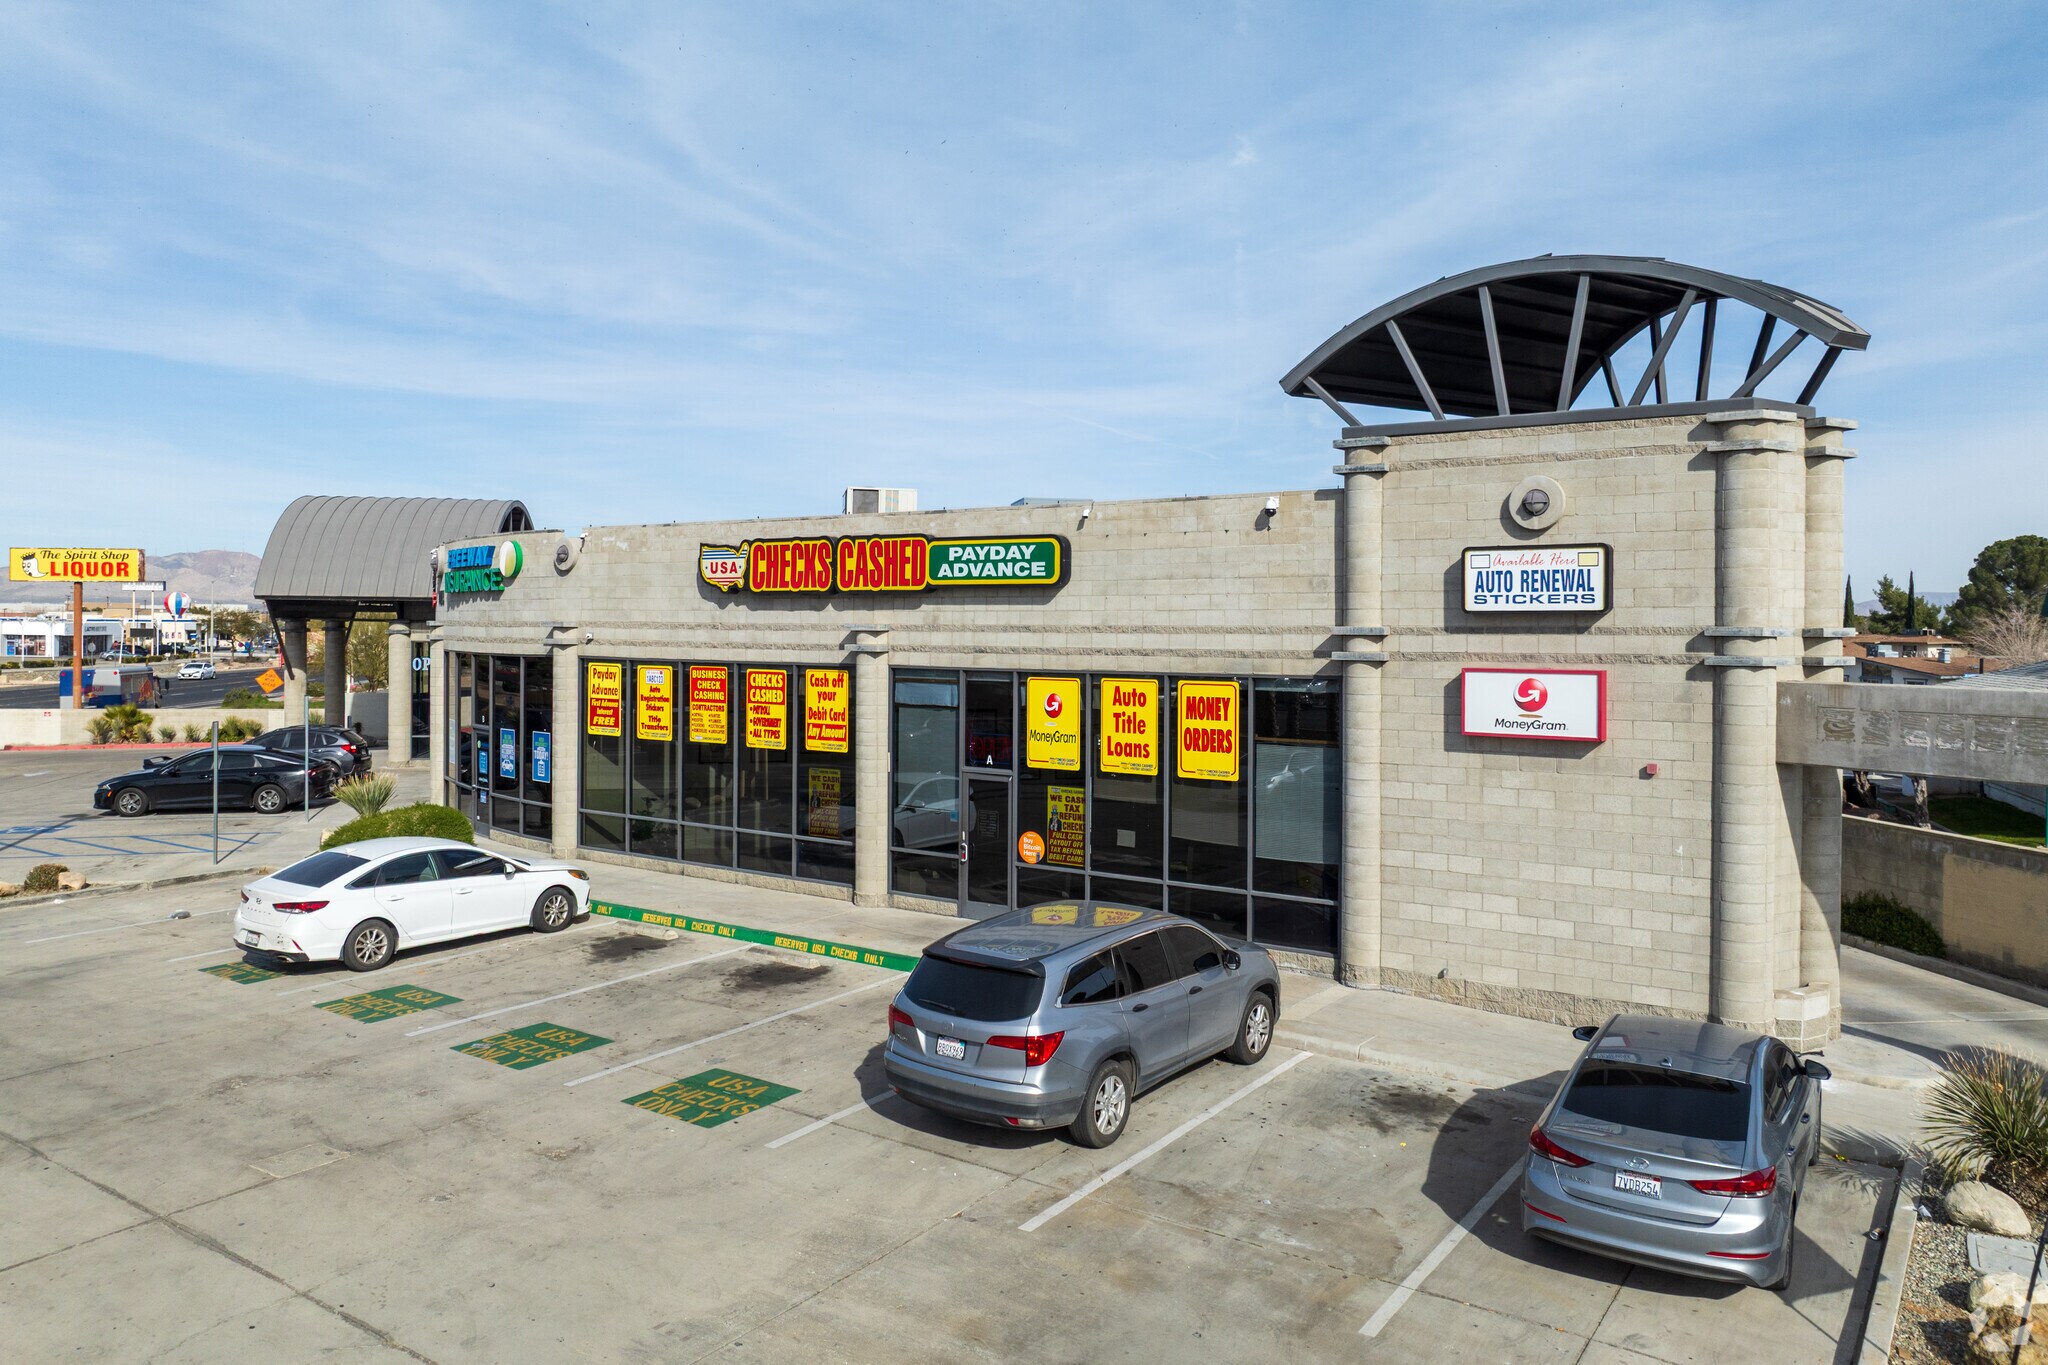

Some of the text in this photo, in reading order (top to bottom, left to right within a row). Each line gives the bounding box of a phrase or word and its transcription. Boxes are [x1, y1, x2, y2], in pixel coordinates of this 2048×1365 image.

[40, 550, 130, 562] The Spirit Shop
[949, 545, 1036, 561] PAYDAY
[1493, 552, 1577, 566] Available Here
[50, 561, 130, 579] LIQUOR
[710, 539, 926, 590] USA CHECKS CASHED
[938, 561, 1046, 578] ADVANCE
[1475, 569, 1595, 593] AUTO RENEWAL
[1474, 593, 1596, 605] STICKERS
[412, 657, 431, 671] OP
[592, 667, 617, 682] Payday
[692, 669, 726, 679] BUSINESS
[750, 673, 783, 688] CHECKS
[810, 672, 844, 688] Cash off
[592, 683, 619, 696] Advance
[697, 680, 721, 690] CHECK
[640, 694, 670, 703] Registration
[694, 690, 725, 700] CASHING
[750, 688, 783, 703] CASHED
[817, 691, 837, 703] your
[1112, 685, 1147, 707] Auto
[645, 703, 664, 712] Stickers
[692, 703, 725, 712] CONTRACTORS
[808, 706, 846, 722] Debit Card
[1185, 696, 1231, 722] MONEY
[592, 716, 616, 726] FREE
[648, 715, 661, 723] Title
[1113, 711, 1146, 734] Title
[1494, 718, 1567, 732] MoneyGram
[641, 722, 668, 731] Transfers
[752, 728, 781, 739] ALL TYPES
[808, 724, 846, 740] Any Amount
[1029, 729, 1077, 746] MoneyGram
[1183, 727, 1233, 754] ORDERS
[1107, 736, 1150, 759] Loans
[986, 755, 993, 765] A
[1050, 794, 1062, 802] WE
[1064, 804, 1080, 813] TAX
[1023, 836, 1033, 845] Buy
[1049, 838, 1072, 847] PAYOUT
[1052, 831, 1083, 841] FULL CASH
[1023, 843, 1042, 851] Bitcoin
[1023, 849, 1036, 857] Here
[1049, 853, 1066, 861] DEBIT
[597, 905, 613, 915] ONLY
[642, 913, 736, 938] RESERVED USA CHECKS ONLY
[774, 936, 885, 966] RESERVED USA CHECKS ONLY
[343, 993, 424, 1014] CHECKS
[395, 989, 445, 1005] USA
[535, 1028, 590, 1047] USA
[482, 1033, 573, 1062] CHECKS
[707, 1075, 769, 1098] USA
[652, 1082, 761, 1116] CHECKS
[632, 1095, 719, 1124] ONLY
